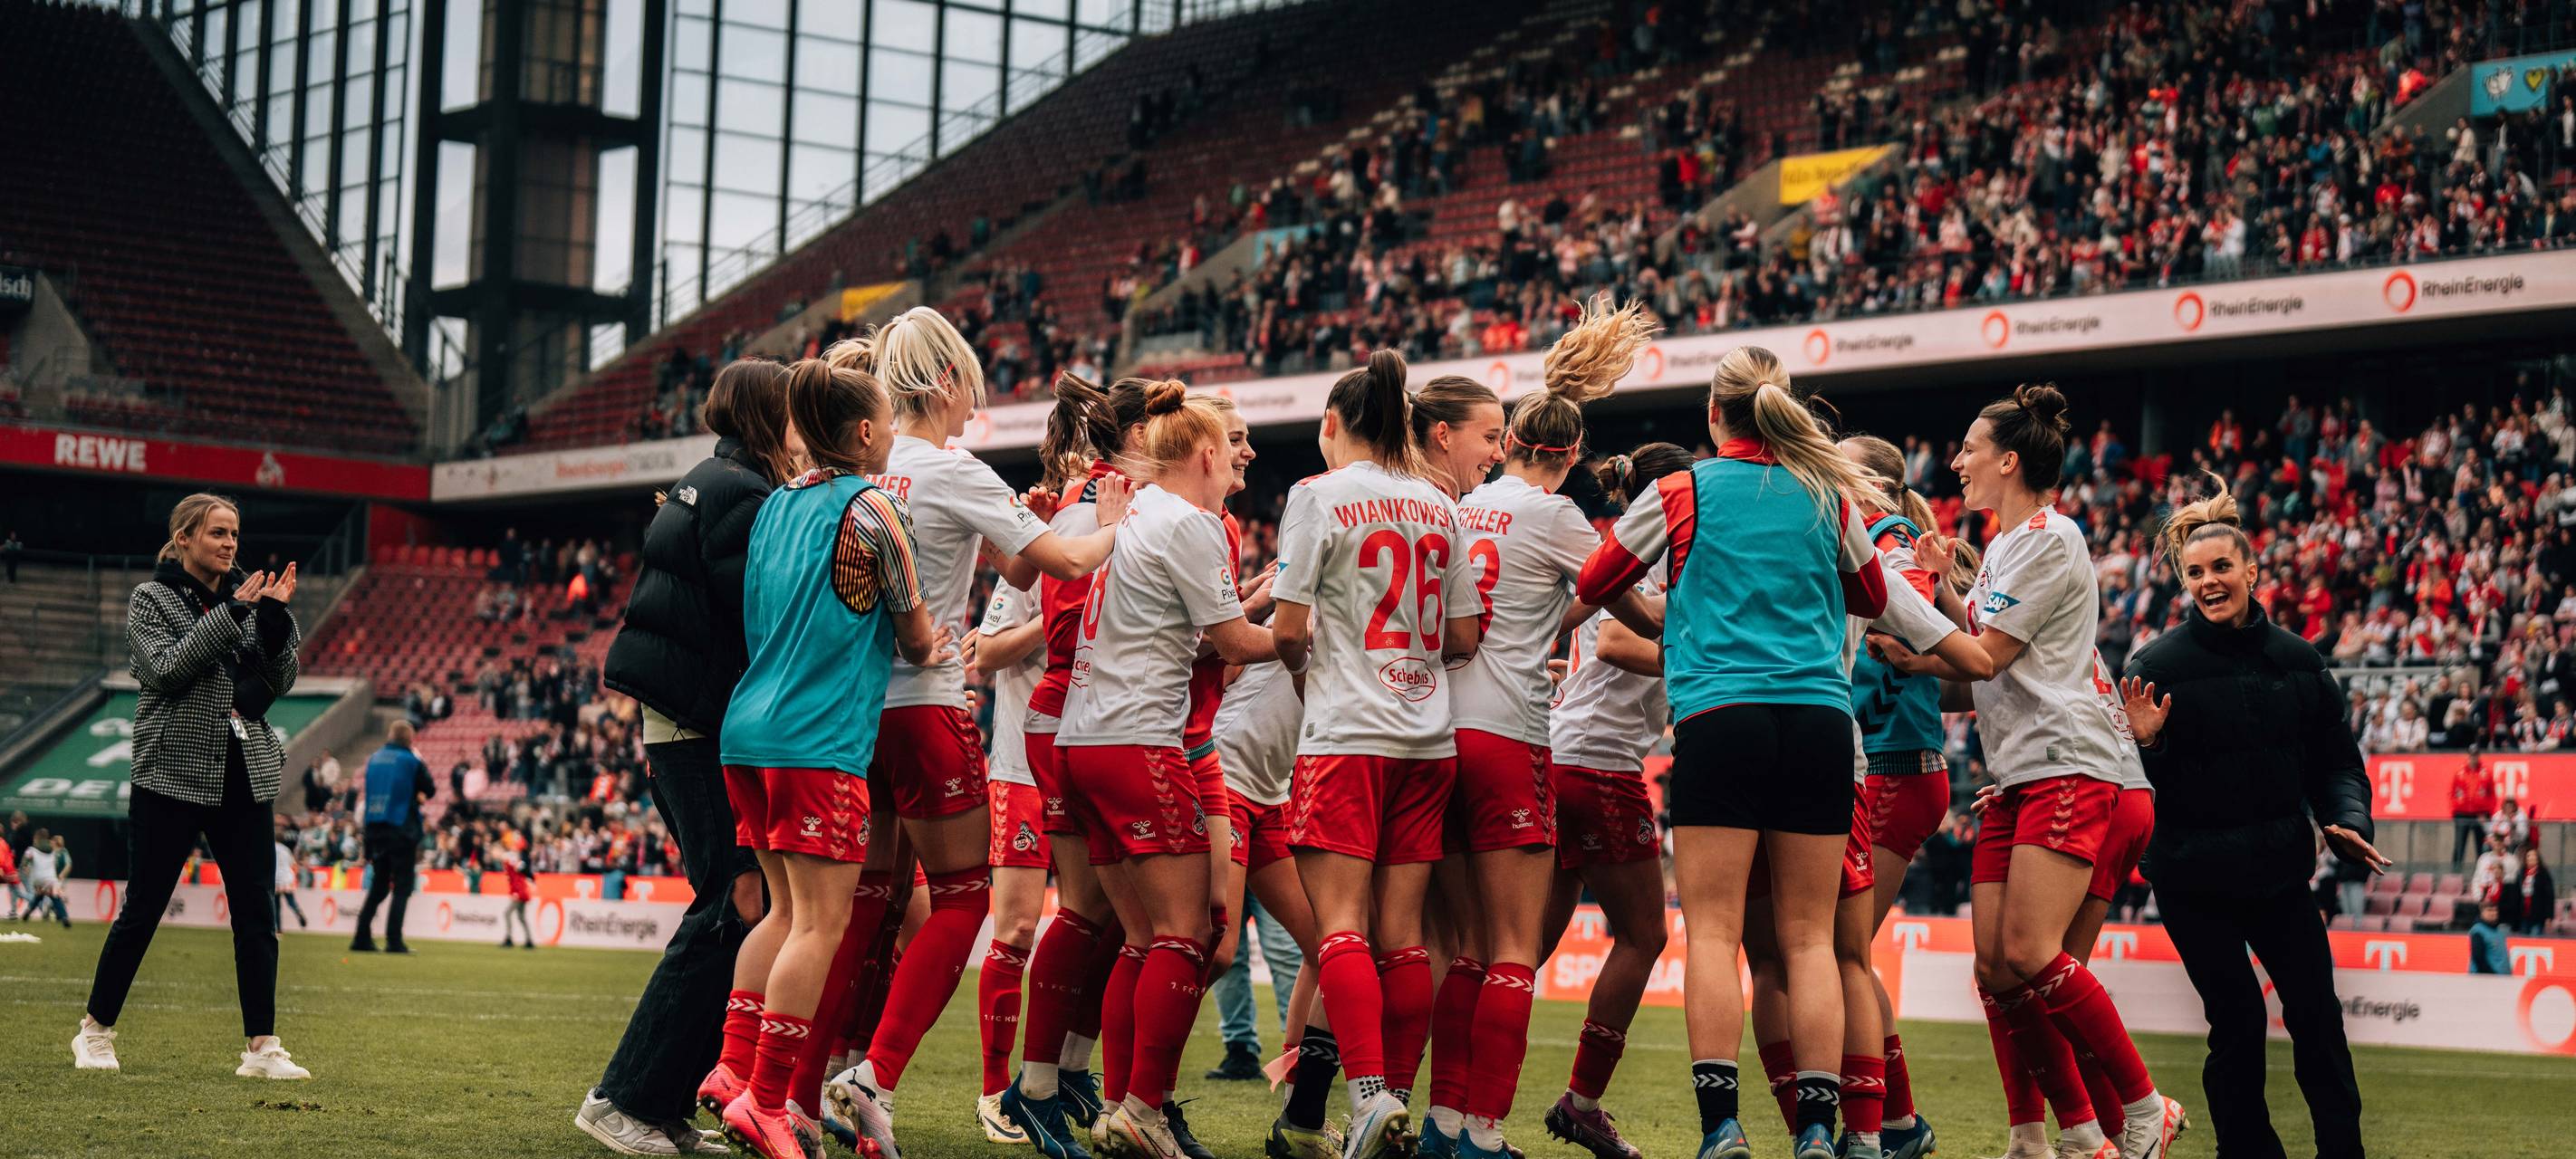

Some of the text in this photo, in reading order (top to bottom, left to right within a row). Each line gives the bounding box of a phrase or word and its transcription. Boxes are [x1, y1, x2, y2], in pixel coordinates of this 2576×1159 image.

[2421, 273, 2523, 298] RheinEnergie
[2210, 295, 2303, 317] RheinEnergie
[54, 434, 147, 473] REWE
[1358, 529, 1450, 651] 26
[1985, 594, 2009, 611] SAP
[2342, 996, 2420, 1022] nEnergie
